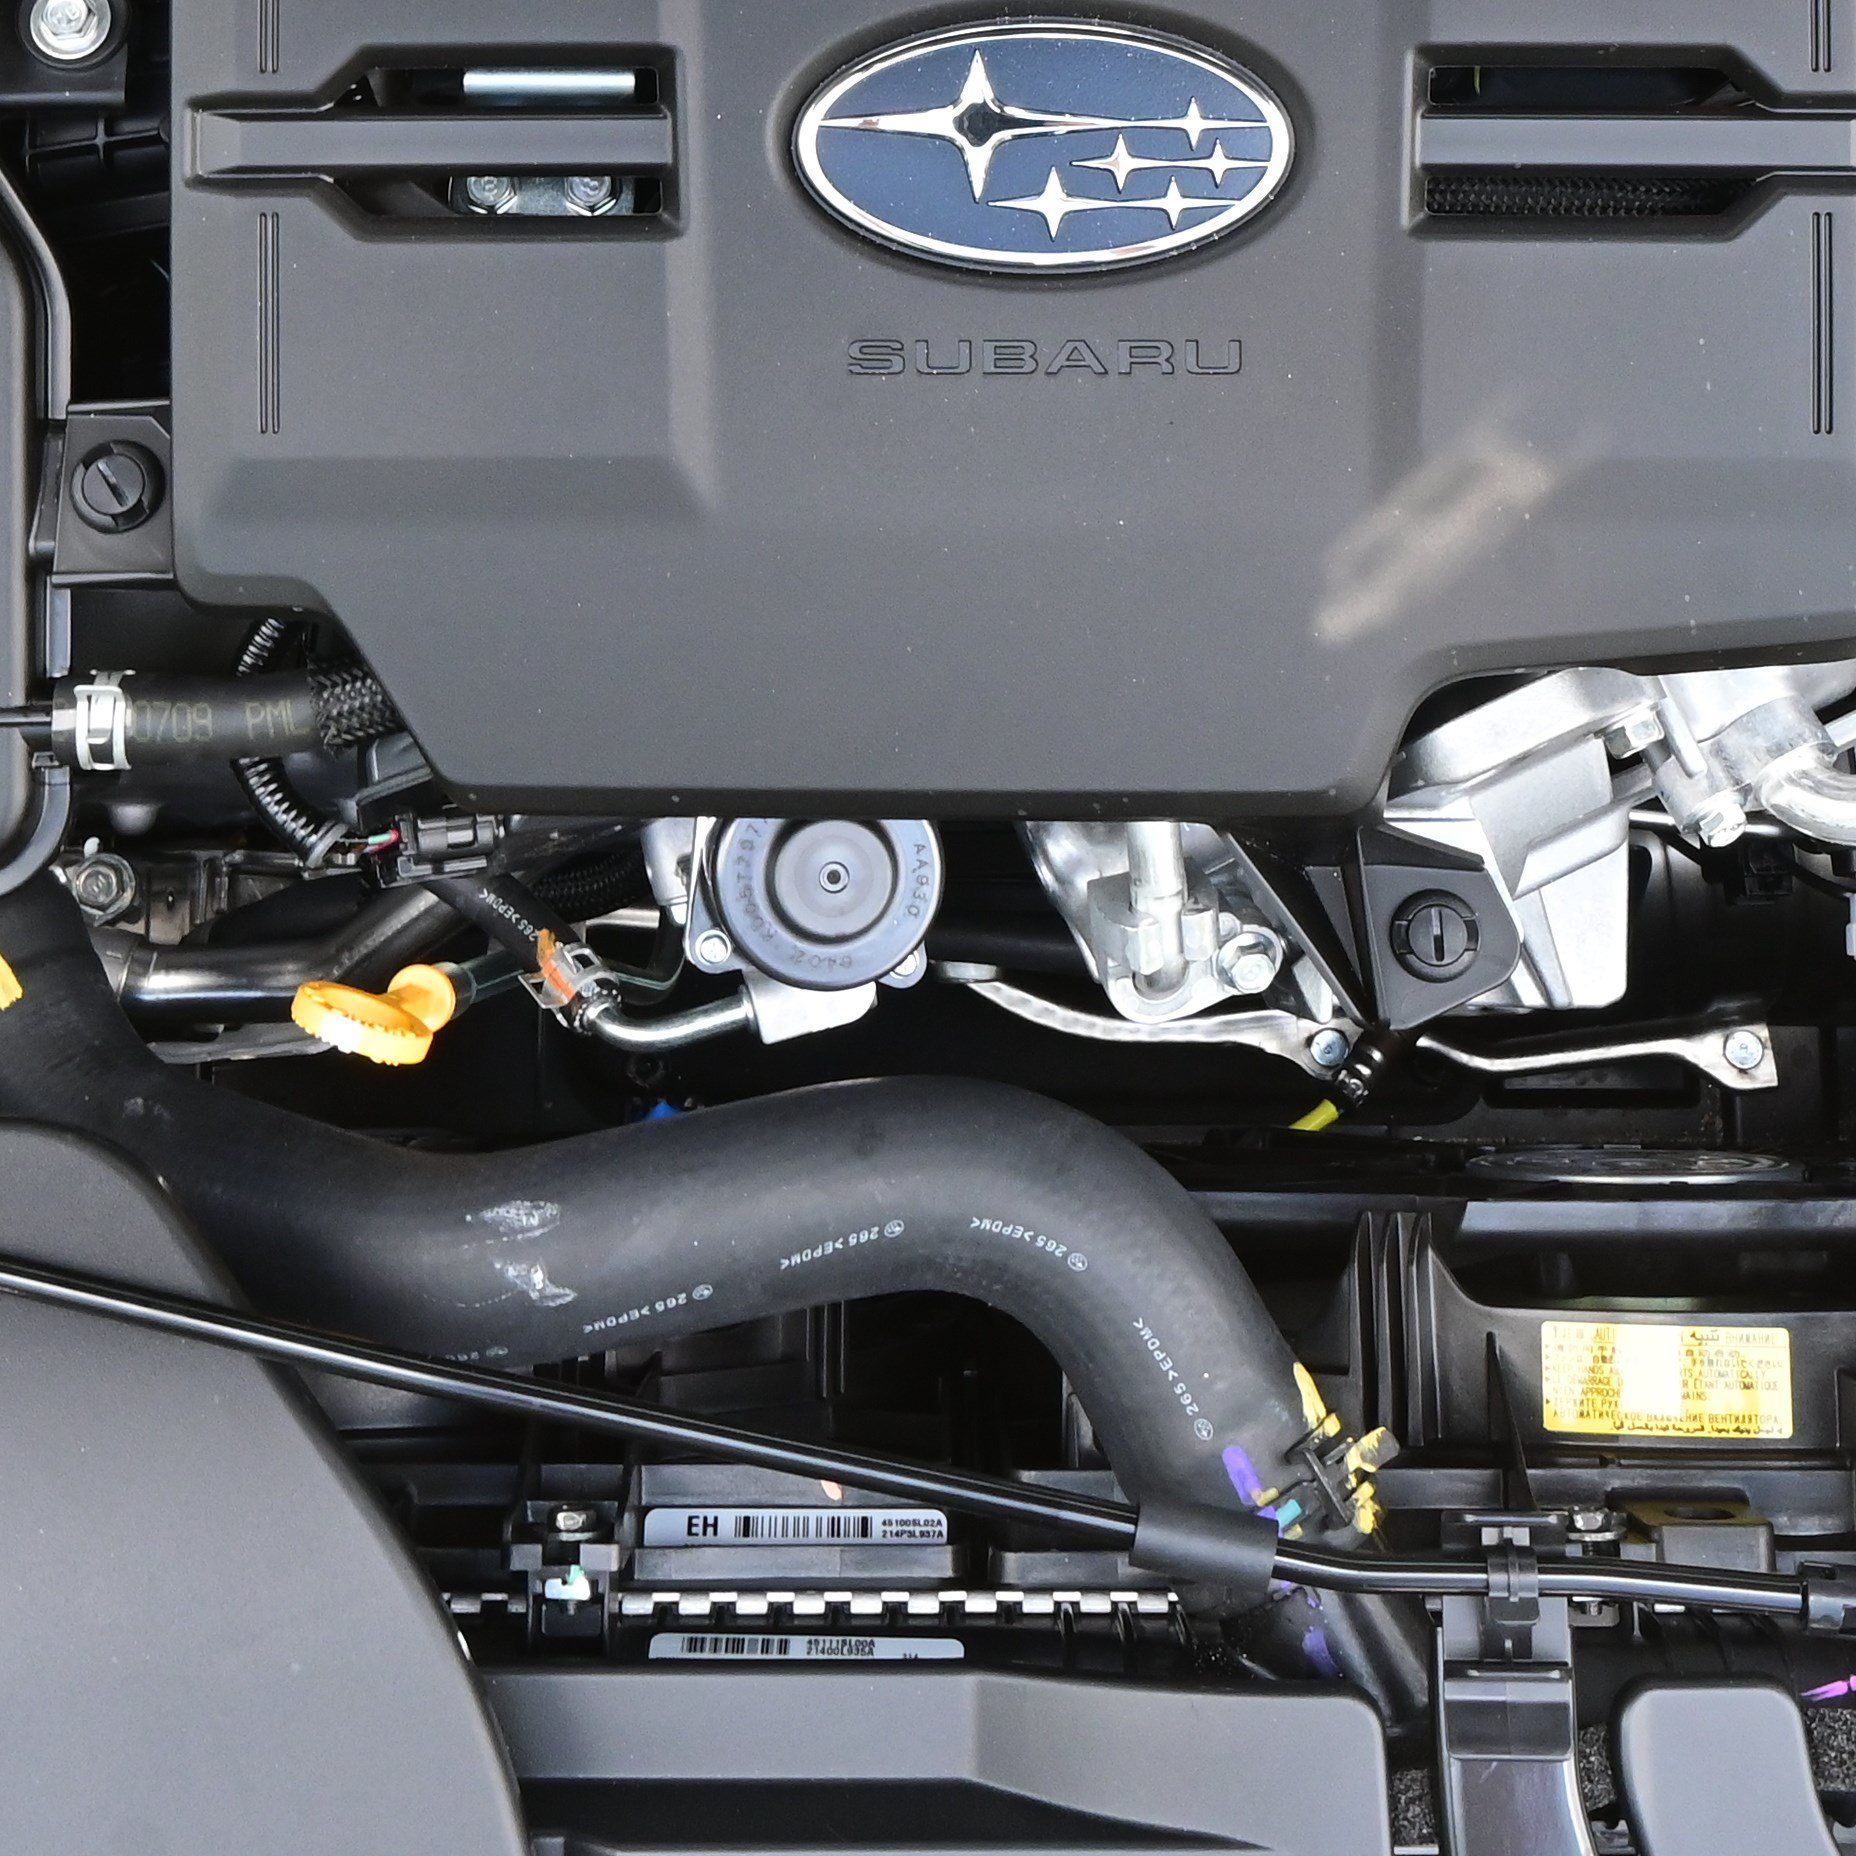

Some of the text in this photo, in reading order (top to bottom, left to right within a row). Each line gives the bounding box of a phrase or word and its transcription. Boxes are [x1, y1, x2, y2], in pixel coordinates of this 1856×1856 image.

[846, 338, 1243, 375] SUBARU
[845, 1225, 881, 1246] 265
[1032, 1232, 1068, 1258] 265
[1172, 1380, 1200, 1417] 265
[685, 1514, 719, 1537] EH
